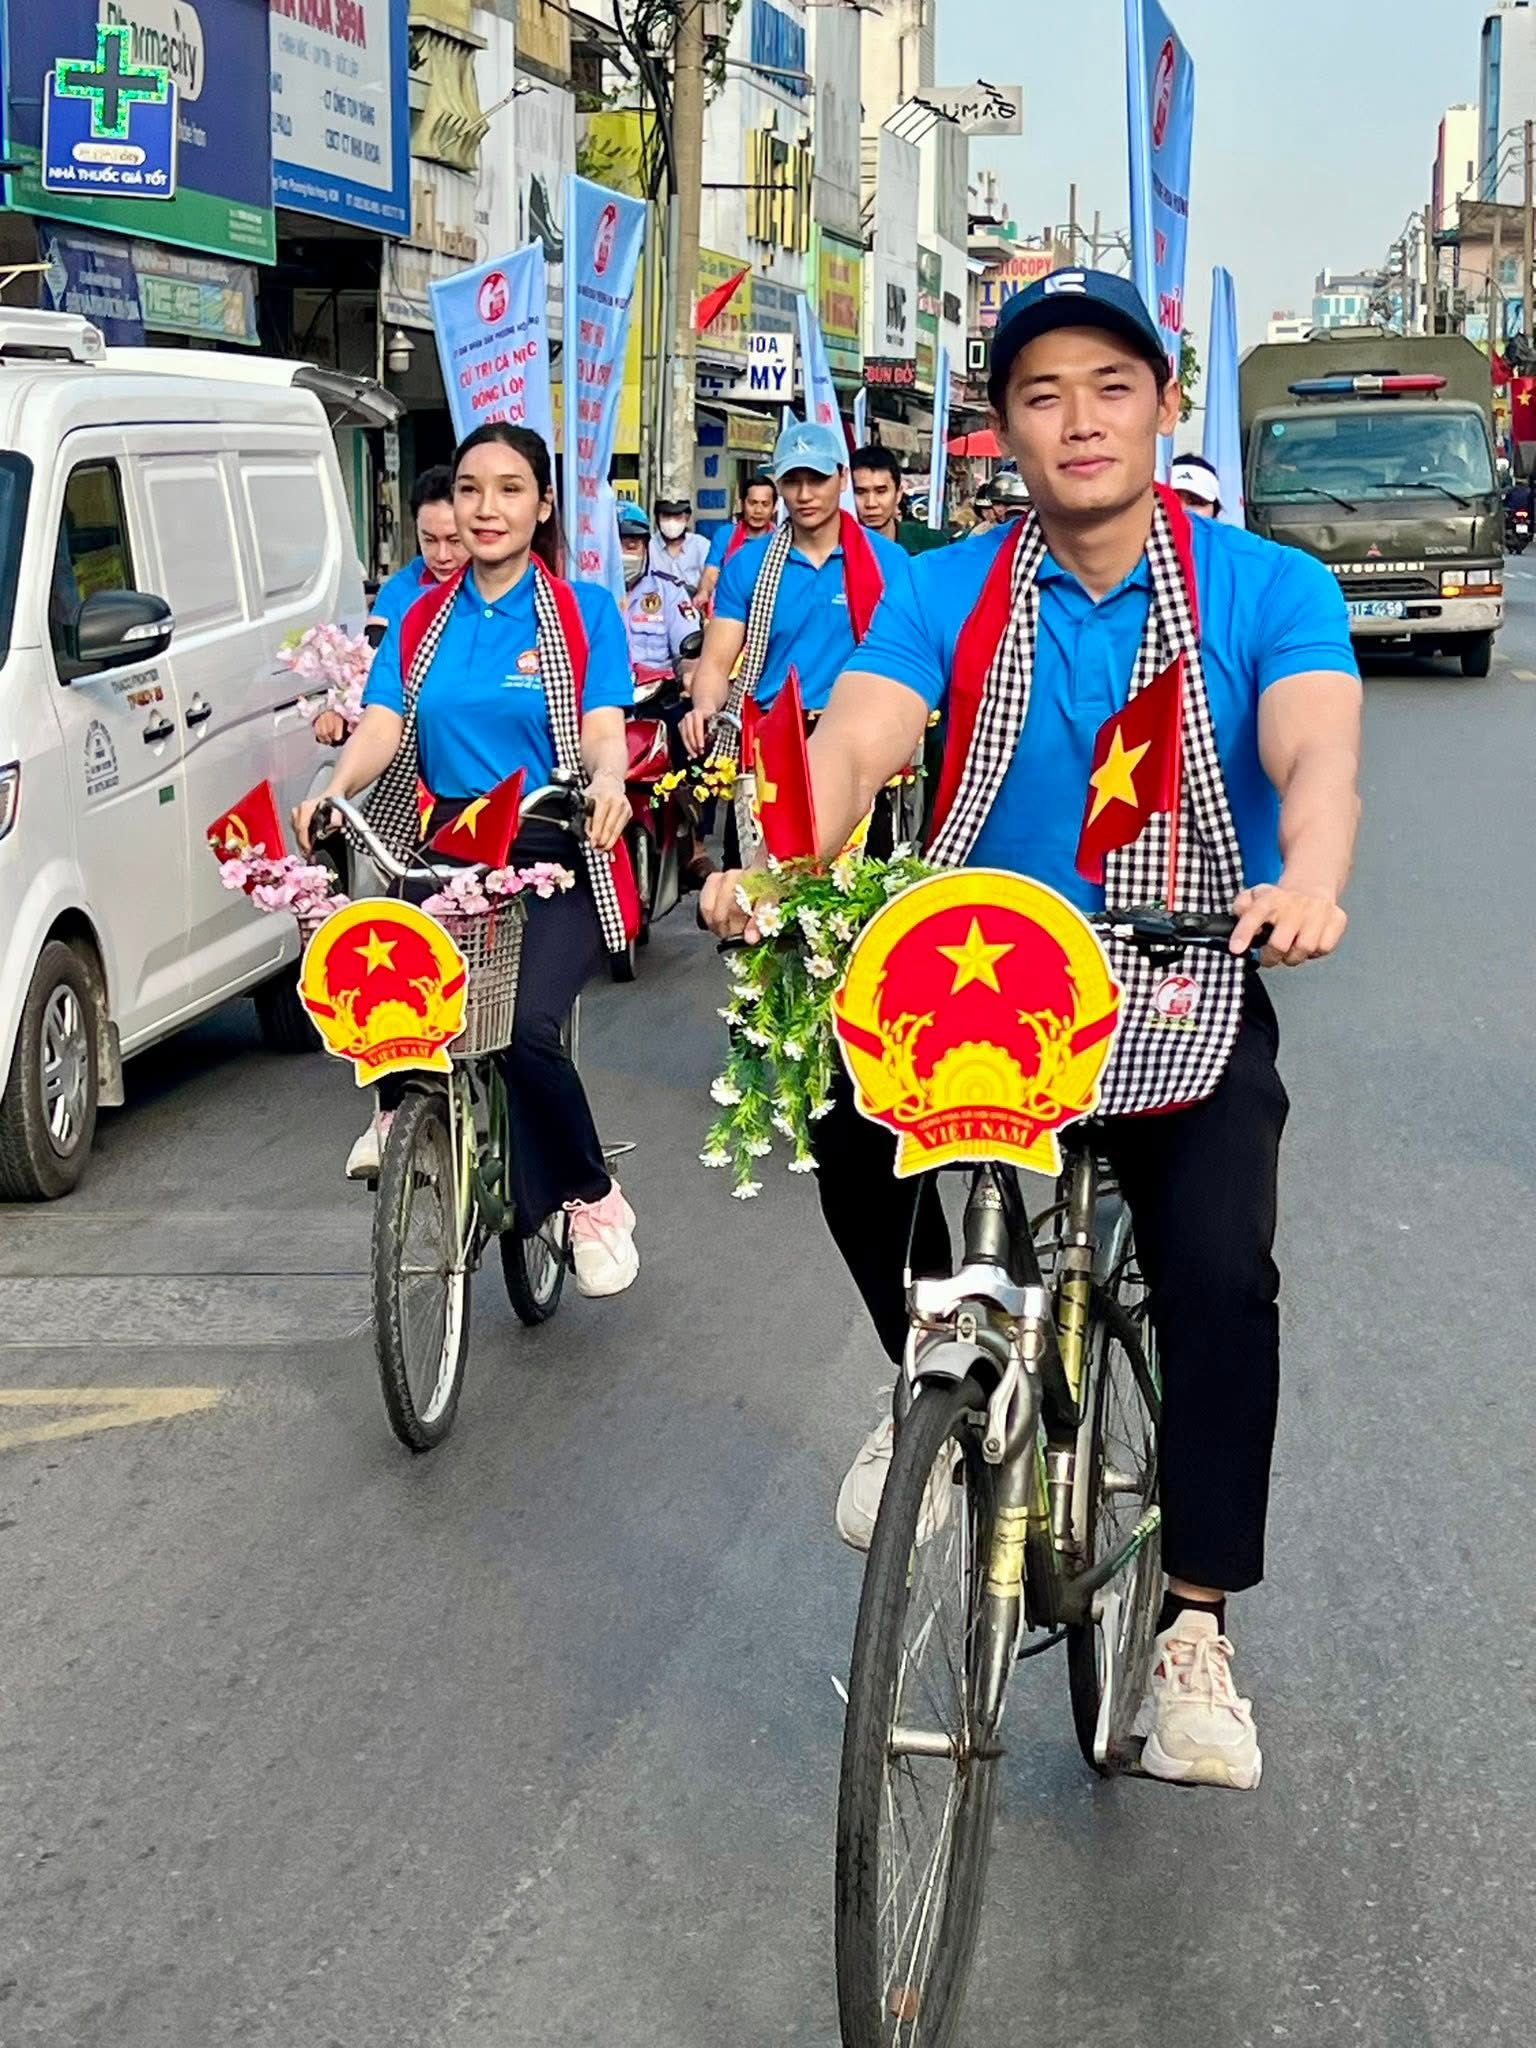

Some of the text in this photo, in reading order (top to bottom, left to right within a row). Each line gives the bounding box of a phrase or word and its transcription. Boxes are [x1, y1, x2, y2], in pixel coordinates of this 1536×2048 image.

[48, 165, 168, 186] NHÀ THUỐC GIÁ TỐT
[985, 257, 1052, 277] OTOCOPY
[475, 361, 492, 380] TRI
[750, 358, 787, 391] MỸ
[924, 1121, 1028, 1146] VIỆT NAM
